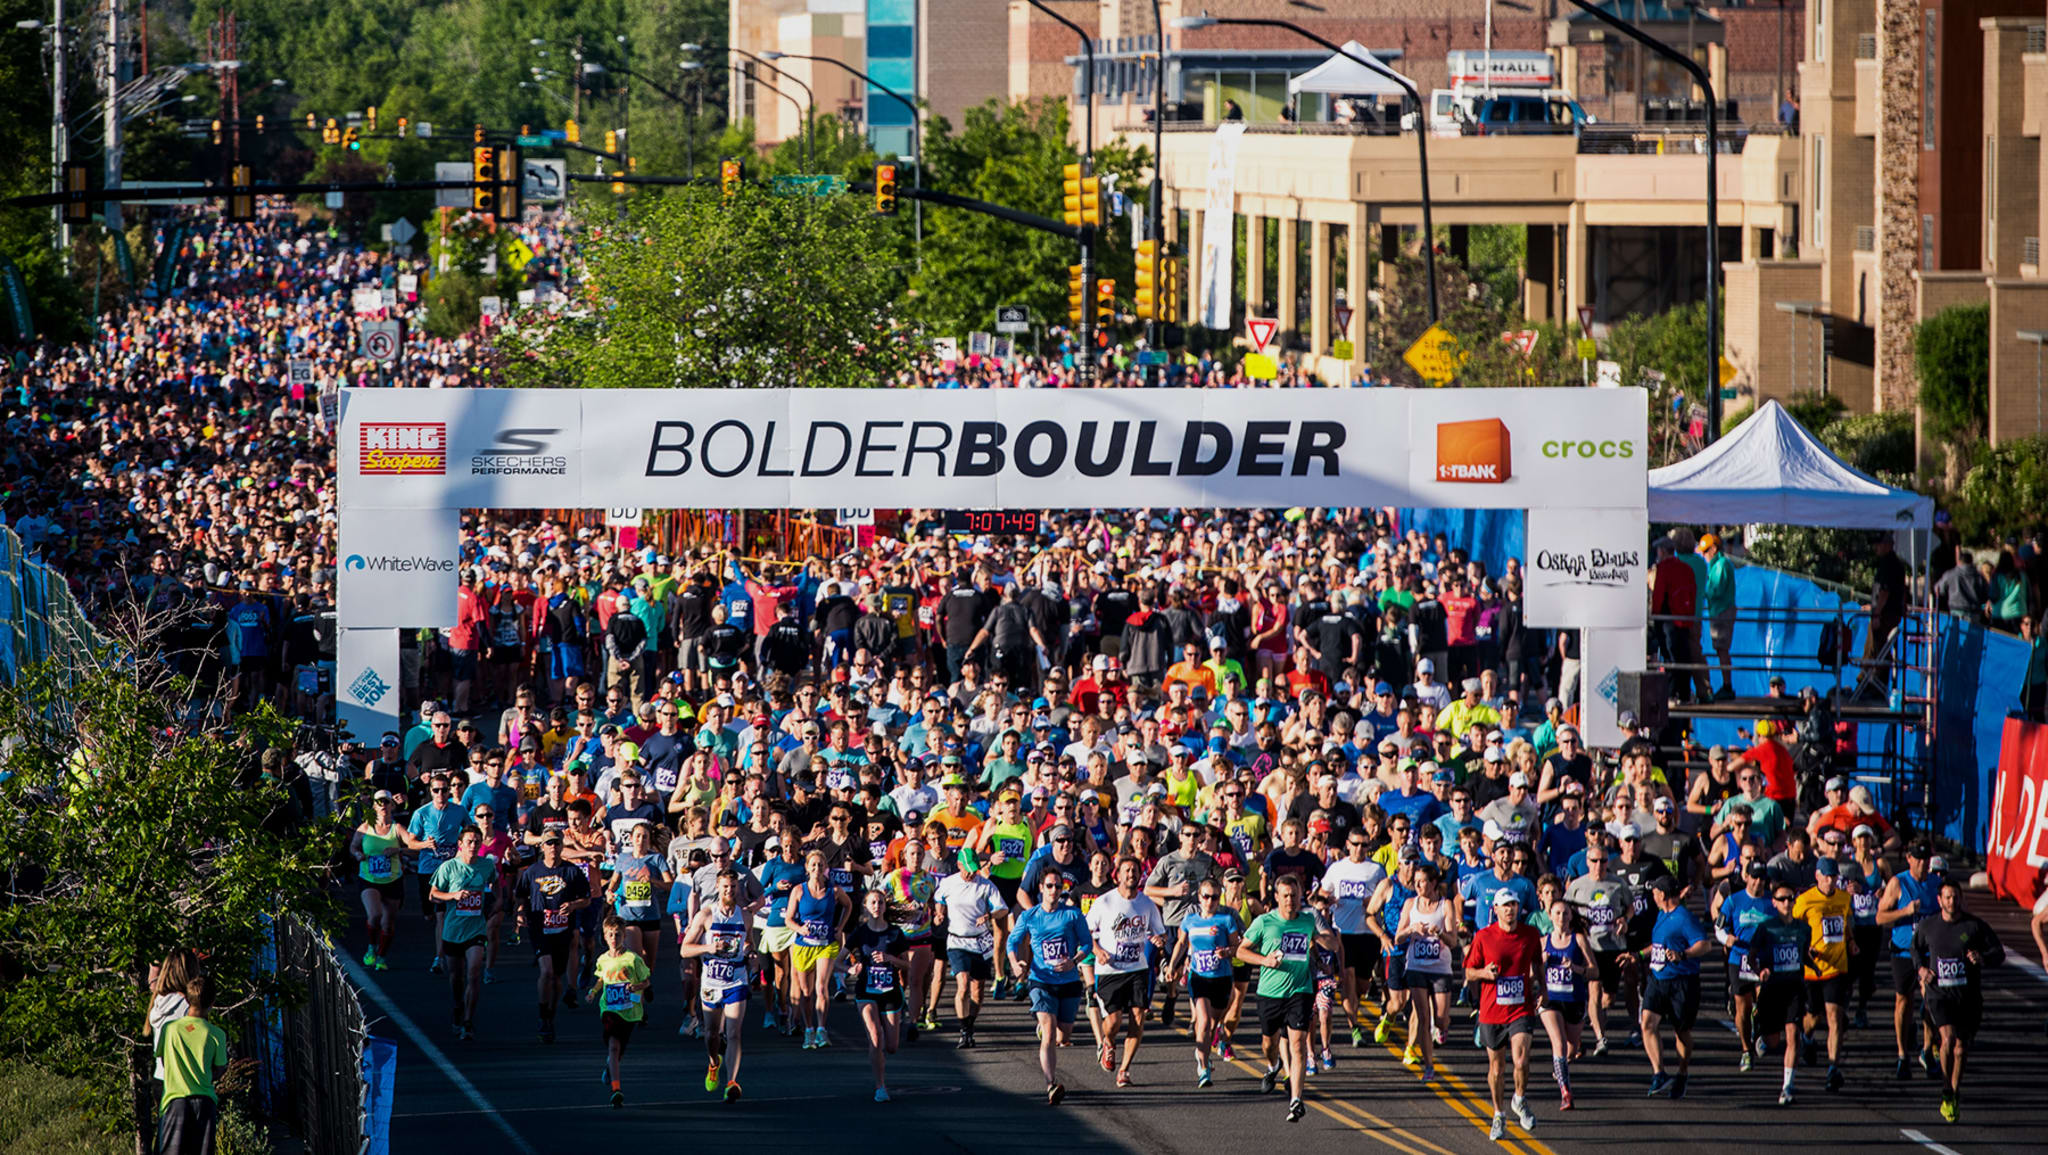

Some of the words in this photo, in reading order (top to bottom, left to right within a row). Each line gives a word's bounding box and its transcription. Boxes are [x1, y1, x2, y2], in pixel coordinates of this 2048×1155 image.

[366, 428, 440, 449] KING
[1542, 440, 1634, 459] crocs
[365, 449, 440, 474] Soopers
[472, 457, 567, 467] SKECHERS
[366, 556, 454, 572] WhiteWave
[356, 673, 381, 700] BEST
[364, 680, 392, 707] 10K
